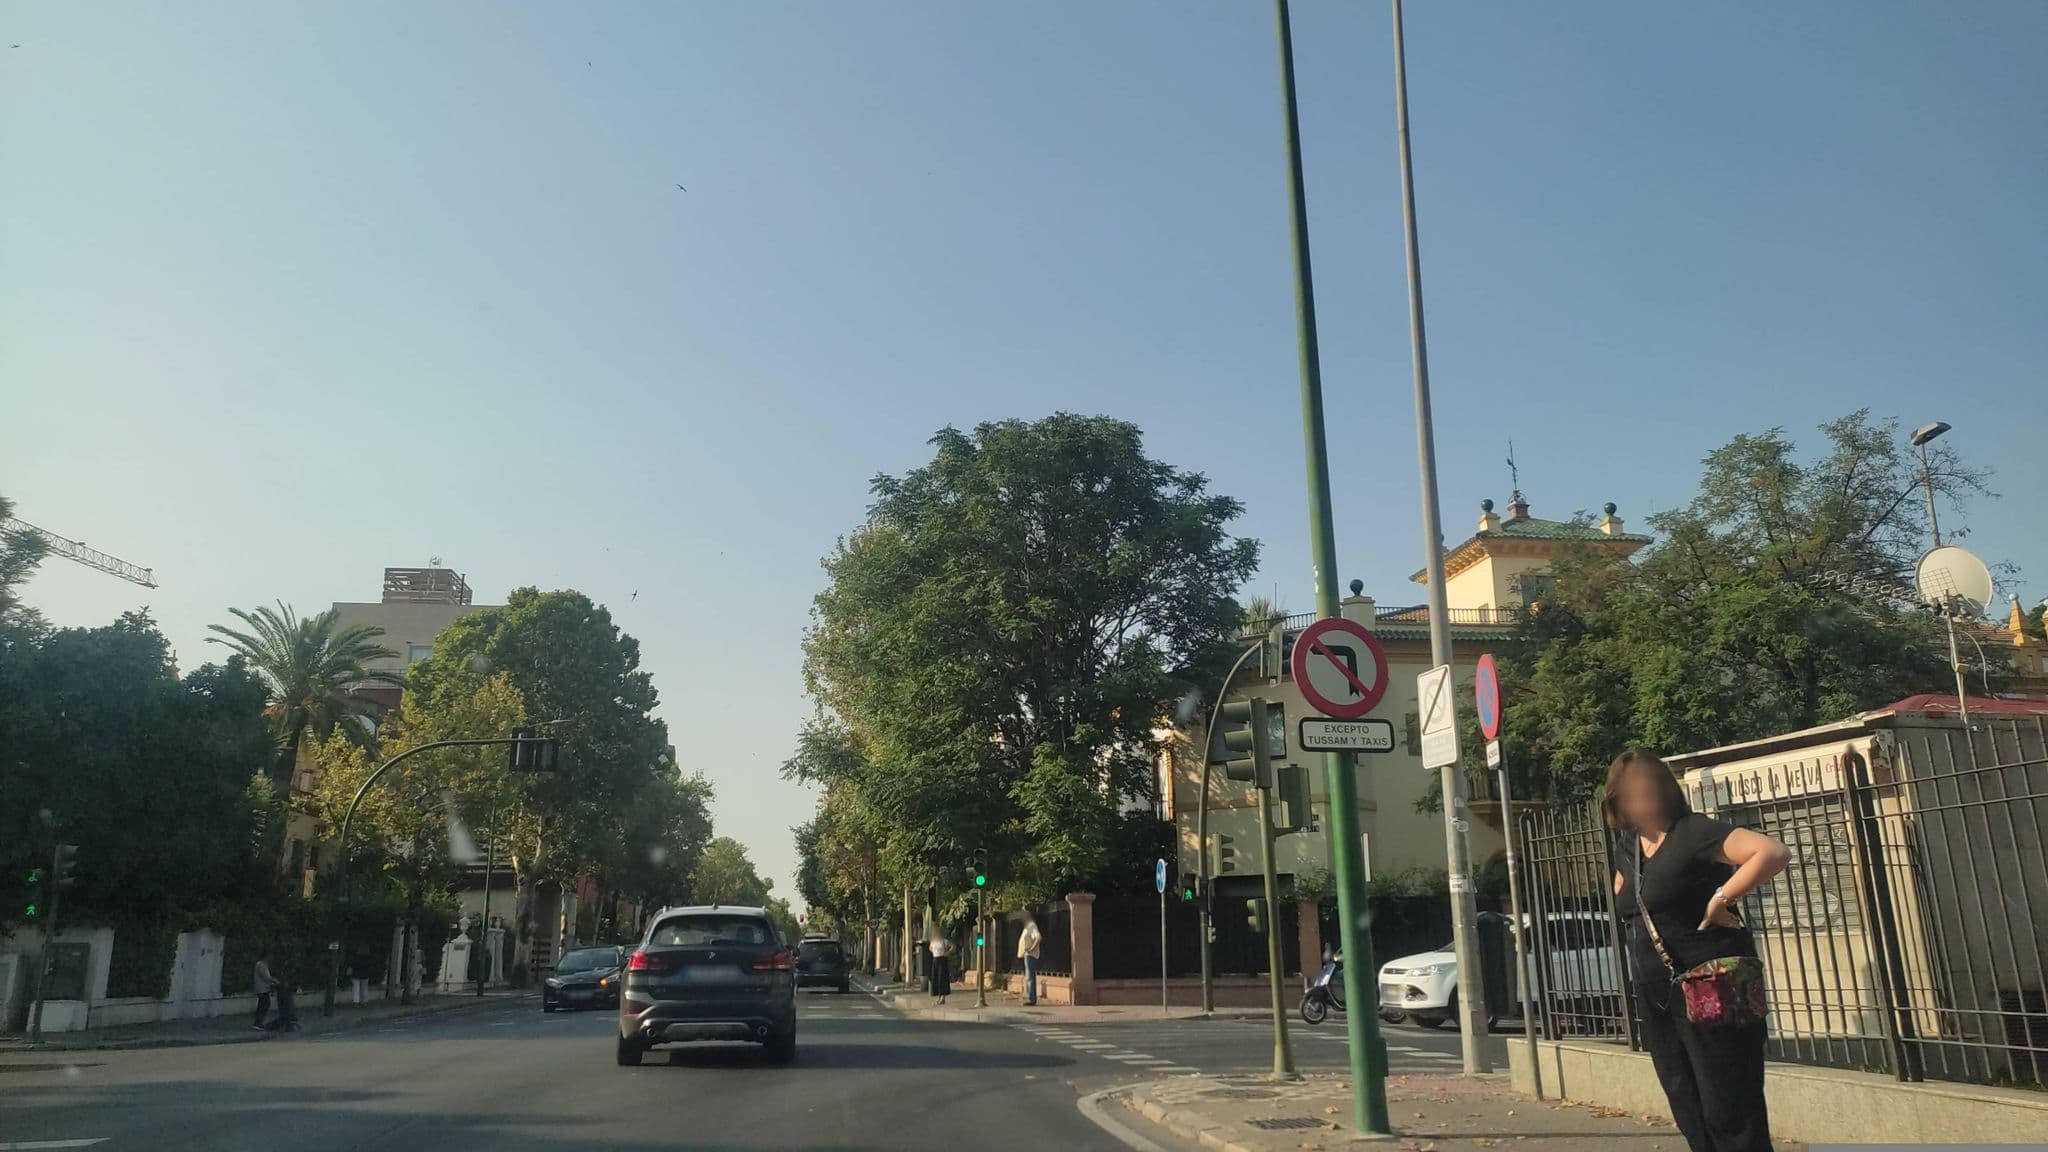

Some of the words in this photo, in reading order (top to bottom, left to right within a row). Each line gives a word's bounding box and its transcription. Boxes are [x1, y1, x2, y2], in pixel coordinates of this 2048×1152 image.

[1324, 724, 1370, 734] EXCEPTO
[1308, 735, 1348, 745] TUSSAM
[1351, 737, 1357, 745] Y
[1361, 736, 1388, 746] TAXIS
